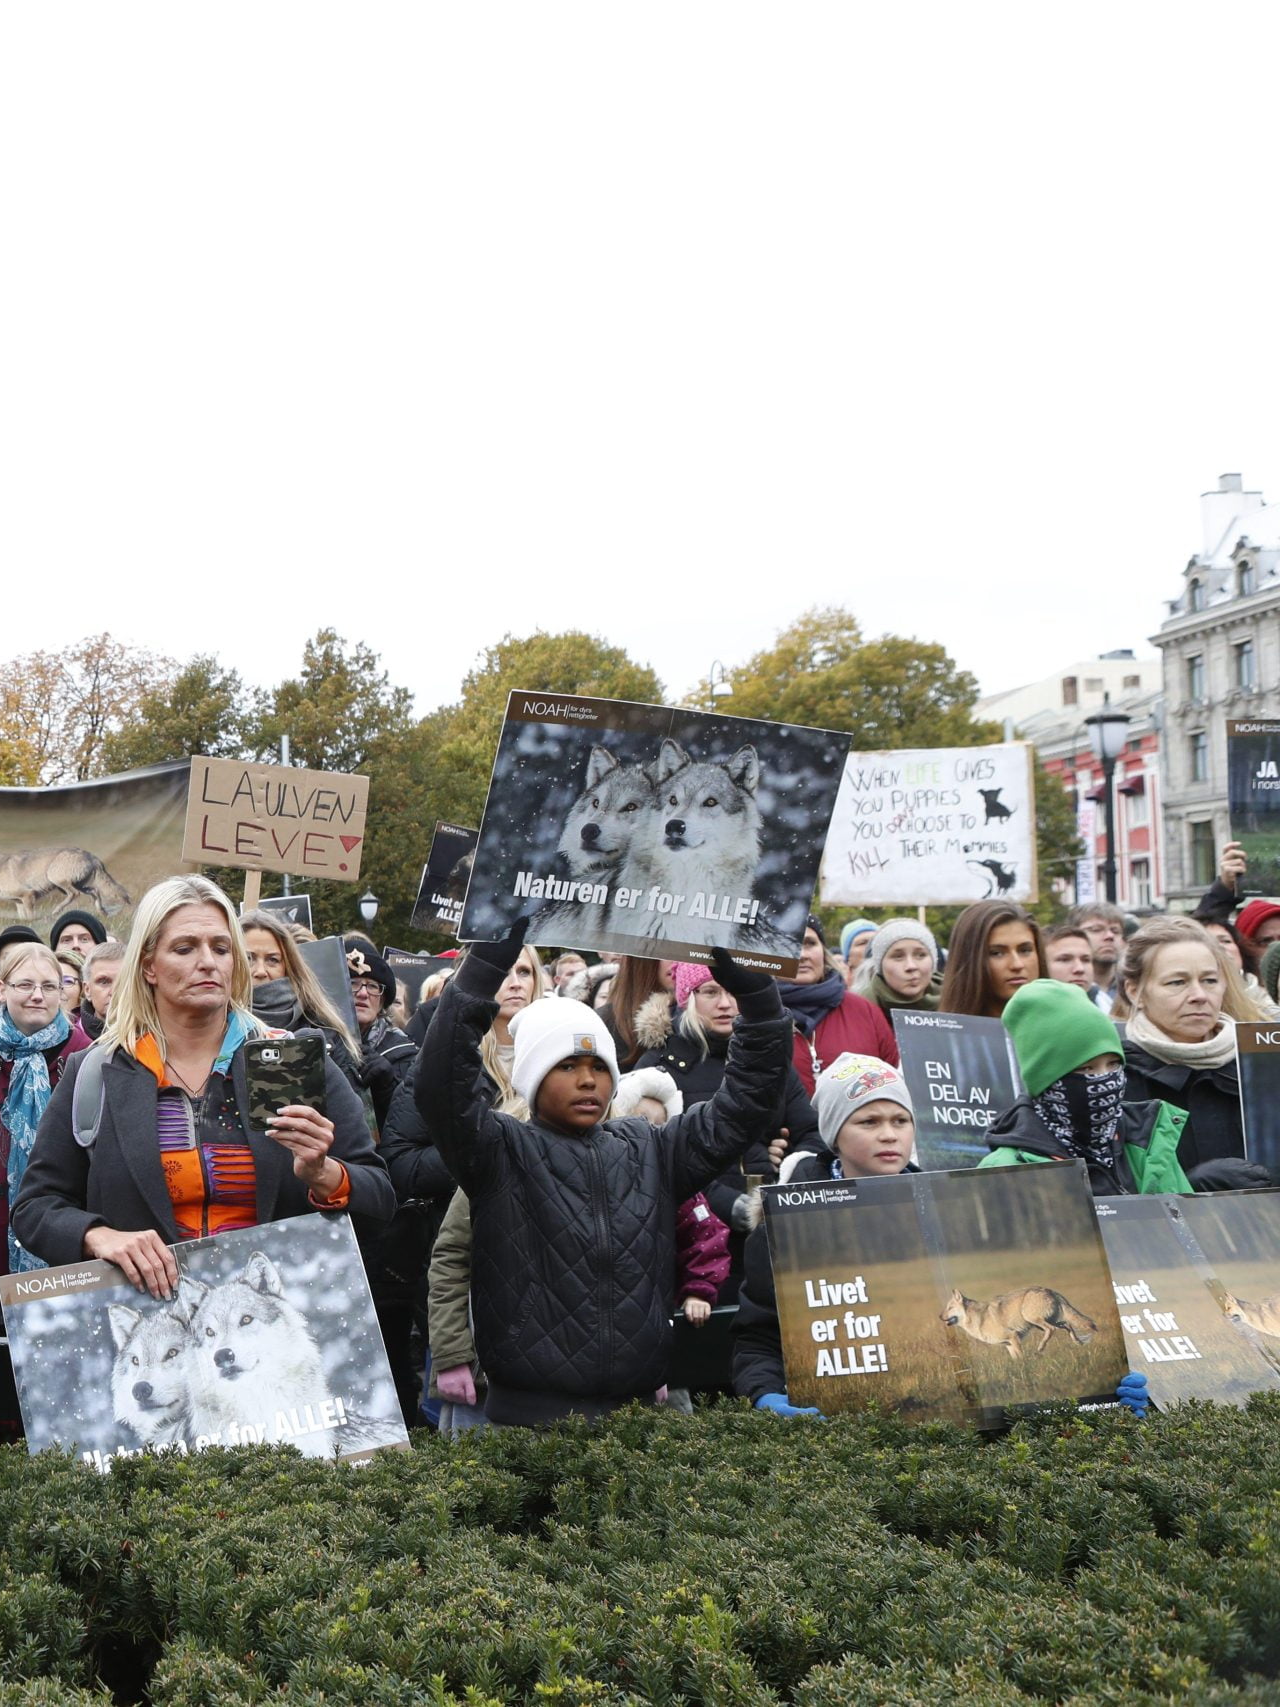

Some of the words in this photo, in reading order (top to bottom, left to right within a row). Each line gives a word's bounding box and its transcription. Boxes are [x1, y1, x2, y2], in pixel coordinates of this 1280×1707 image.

[523, 701, 568, 717] NOAH
[1235, 723, 1265, 732] NOAH
[846, 768, 901, 792] WHEN
[905, 761, 943, 785] LIFE
[954, 758, 996, 783] GIVES
[1256, 761, 1279, 778] JA
[202, 766, 256, 813] LA
[265, 781, 356, 825] ULVEN
[1258, 780, 1280, 790] nors
[852, 797, 884, 816] YOU
[891, 789, 961, 811] PUPPIES
[441, 825, 459, 835] NOAH
[852, 821, 883, 841] YOU
[959, 813, 977, 830] TO
[848, 846, 890, 876] KILL
[899, 838, 938, 859] THEIR
[431, 893, 453, 907] Livet
[453, 900, 464, 910] er
[513, 871, 609, 905] Naturen
[614, 886, 642, 909] er
[648, 885, 686, 915] for
[688, 892, 761, 926] ALLE!
[904, 1015, 939, 1027] NOAH
[925, 1061, 951, 1080] EN
[929, 1083, 966, 1103] DEL
[969, 1086, 990, 1105] AV
[777, 1190, 824, 1206] NOAH
[16, 1275, 66, 1296] NOAH
[805, 1275, 869, 1308] Livet
[1112, 1279, 1158, 1305] ivet
[811, 1318, 838, 1342] er
[843, 1311, 881, 1339] for
[1121, 1313, 1146, 1333] er
[1143, 1308, 1180, 1332] for
[816, 1343, 889, 1377] ALLE!
[1137, 1335, 1203, 1363] ALLE!
[275, 1396, 348, 1441] ALLE!
